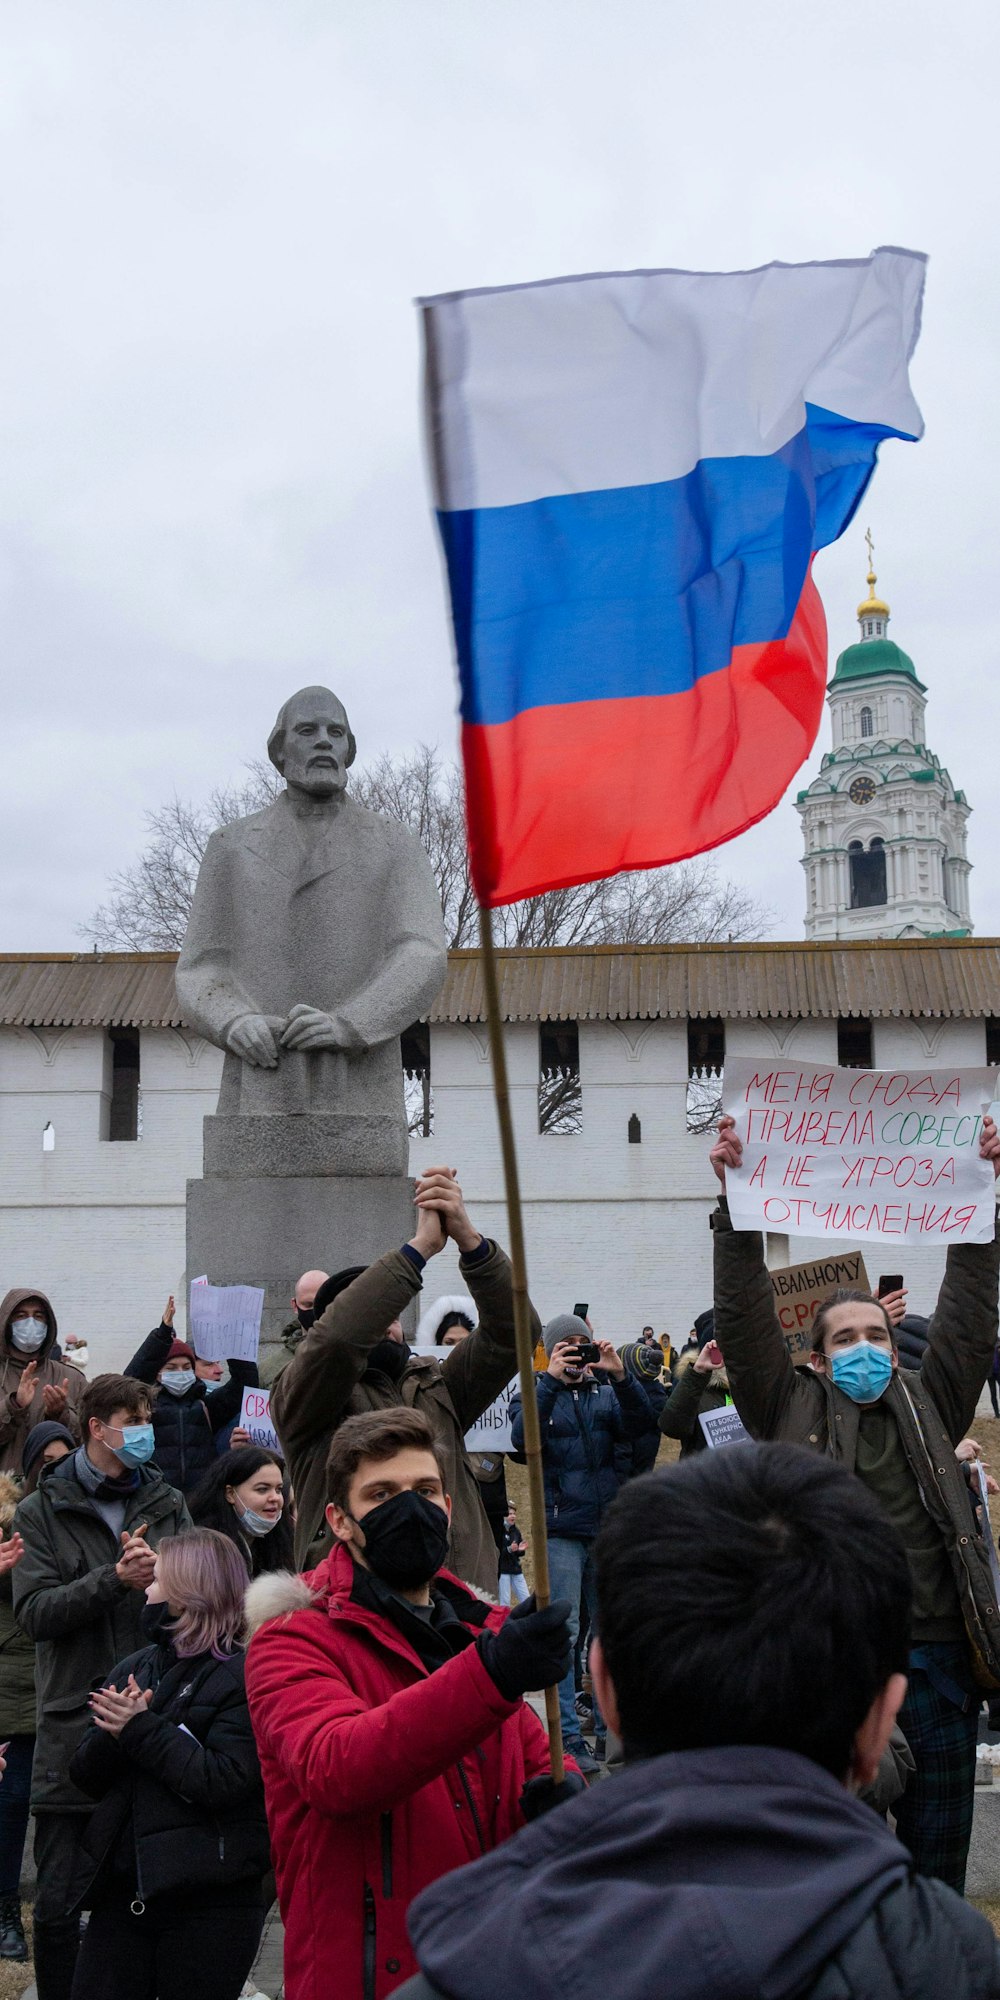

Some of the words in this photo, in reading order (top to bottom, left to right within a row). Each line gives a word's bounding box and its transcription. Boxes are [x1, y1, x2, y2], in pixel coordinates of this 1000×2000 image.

[745, 1071, 834, 1103] МЕНЯ
[848, 1074, 960, 1106] СЮДА
[747, 1108, 874, 1145] ПРИВЕЛА
[881, 1111, 983, 1148] СОВЕСТ
[749, 1155, 767, 1188] А
[783, 1155, 817, 1187] НЕ
[841, 1155, 955, 1188] УГРОЗА
[763, 1197, 977, 1234] ОТЧИСЛЕНИЯ
[708, 1420, 717, 1428] НЕ
